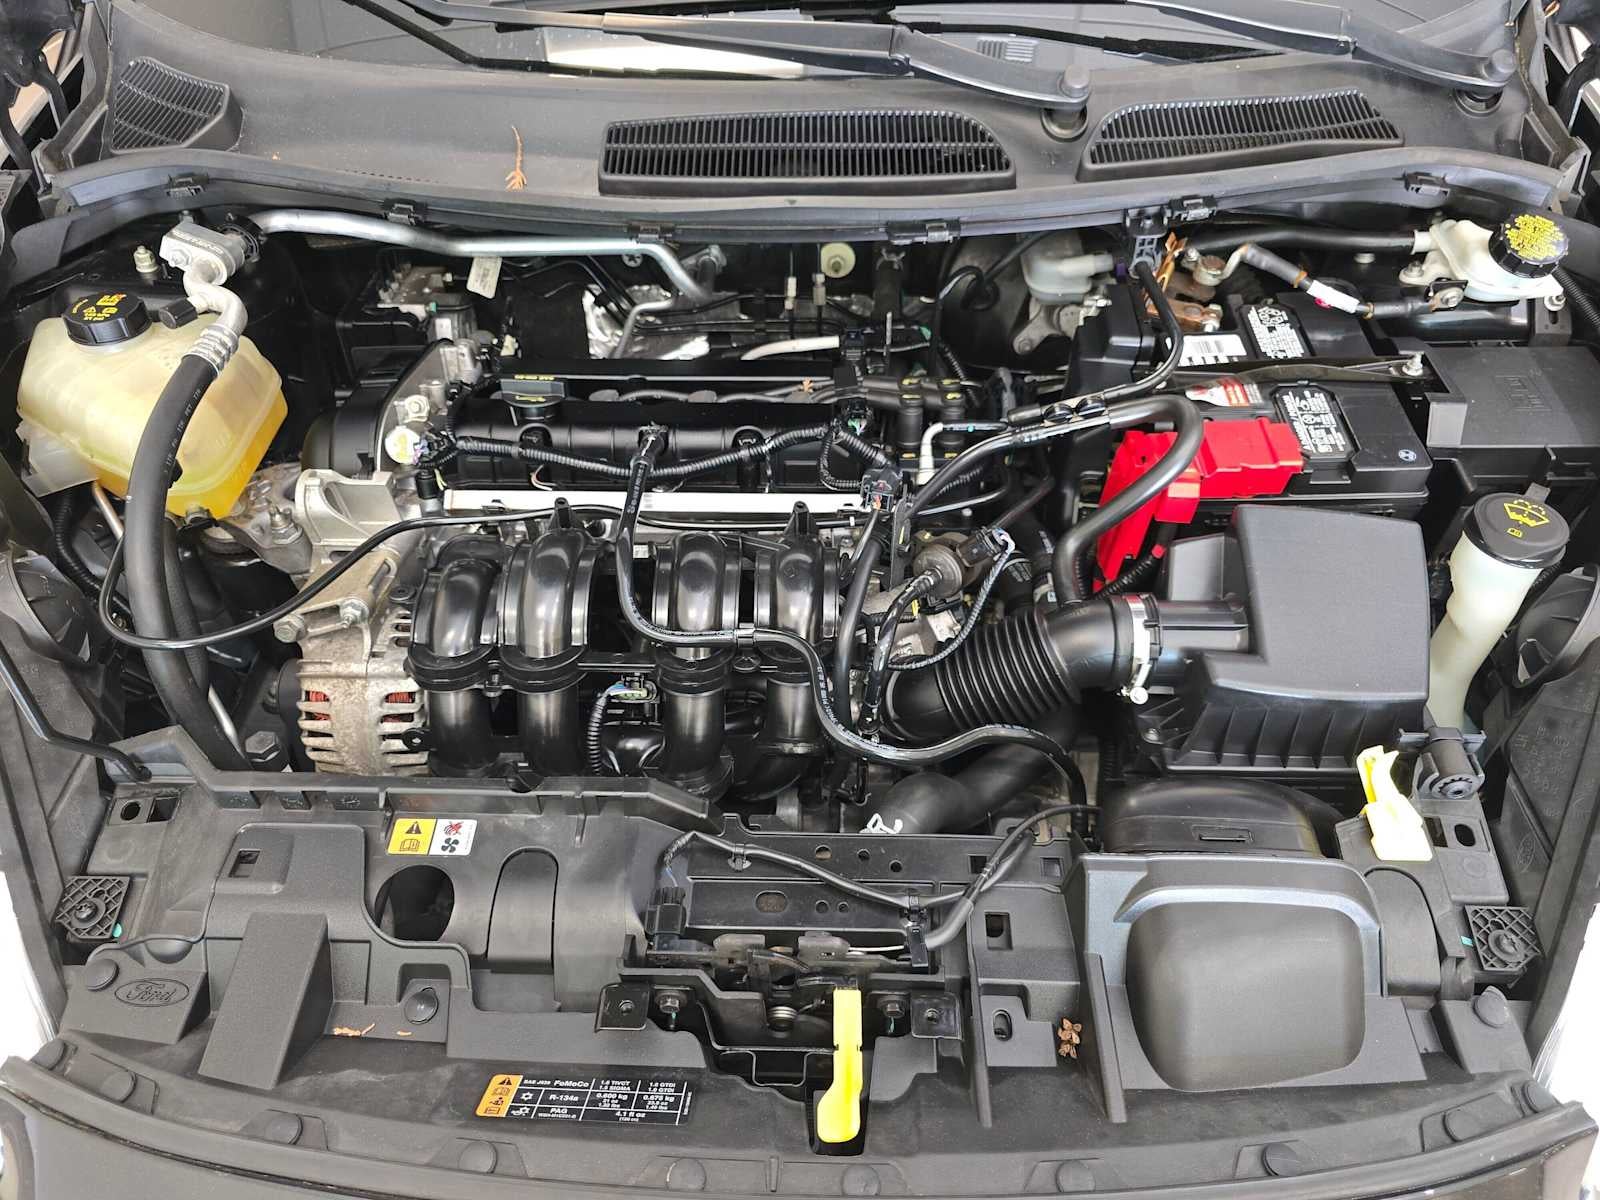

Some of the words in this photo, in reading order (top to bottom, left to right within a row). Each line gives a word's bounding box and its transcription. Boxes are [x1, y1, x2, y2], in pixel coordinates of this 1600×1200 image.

[126, 983, 177, 1002] Ford
[553, 1080, 590, 1088] FoMoCo
[549, 1094, 579, 1102] R-134a
